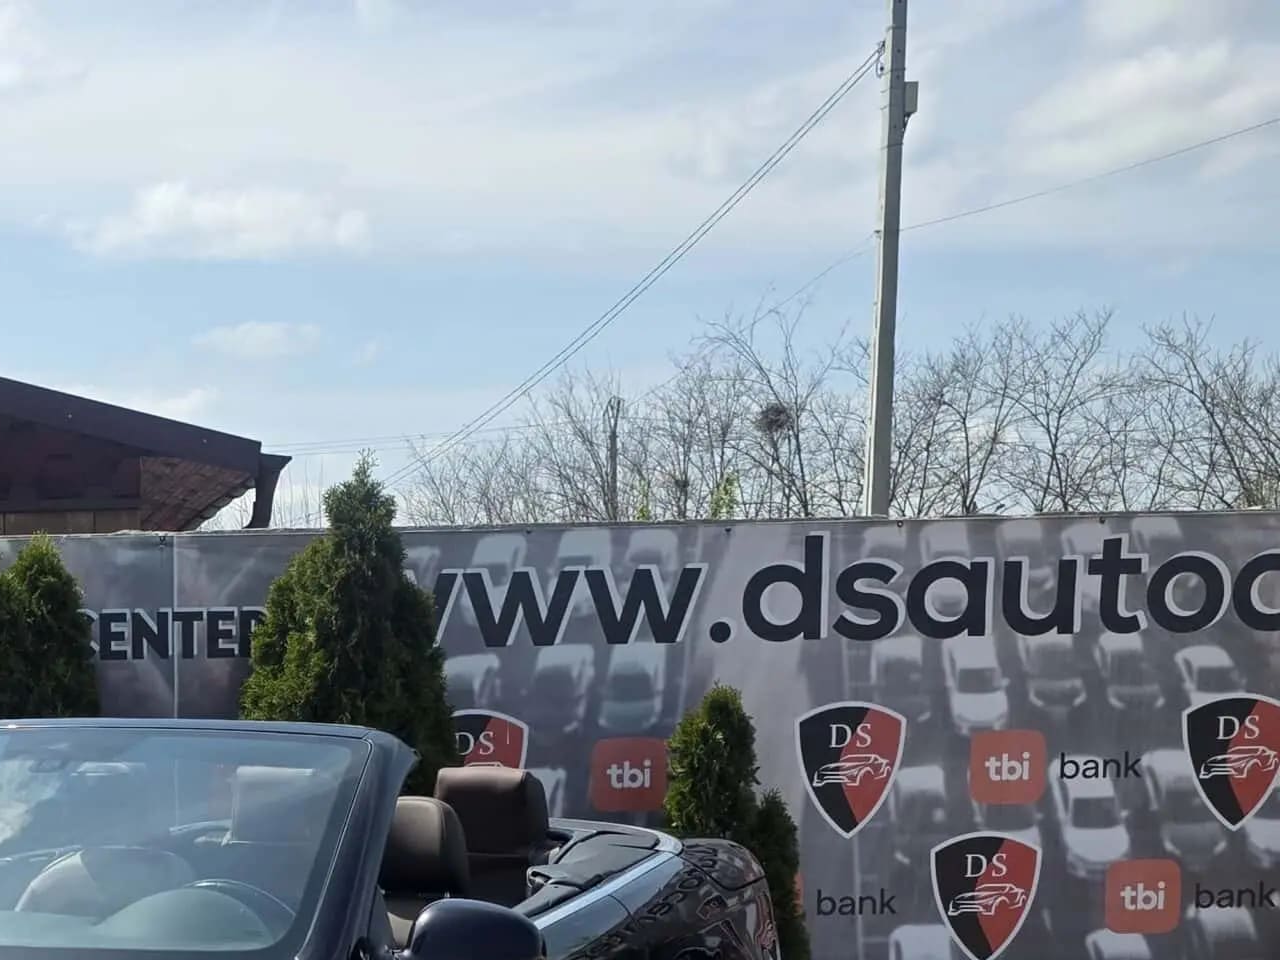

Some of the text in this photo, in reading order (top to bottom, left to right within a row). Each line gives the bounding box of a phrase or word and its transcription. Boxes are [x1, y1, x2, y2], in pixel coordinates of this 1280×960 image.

[829, 723, 872, 749] DS
[1216, 714, 1261, 741] DS
[606, 760, 653, 789] tbi
[984, 752, 1142, 781] tbi bank
[964, 852, 1009, 877] DS
[816, 888, 897, 916] bank
[1120, 880, 1277, 910] tbi bank
